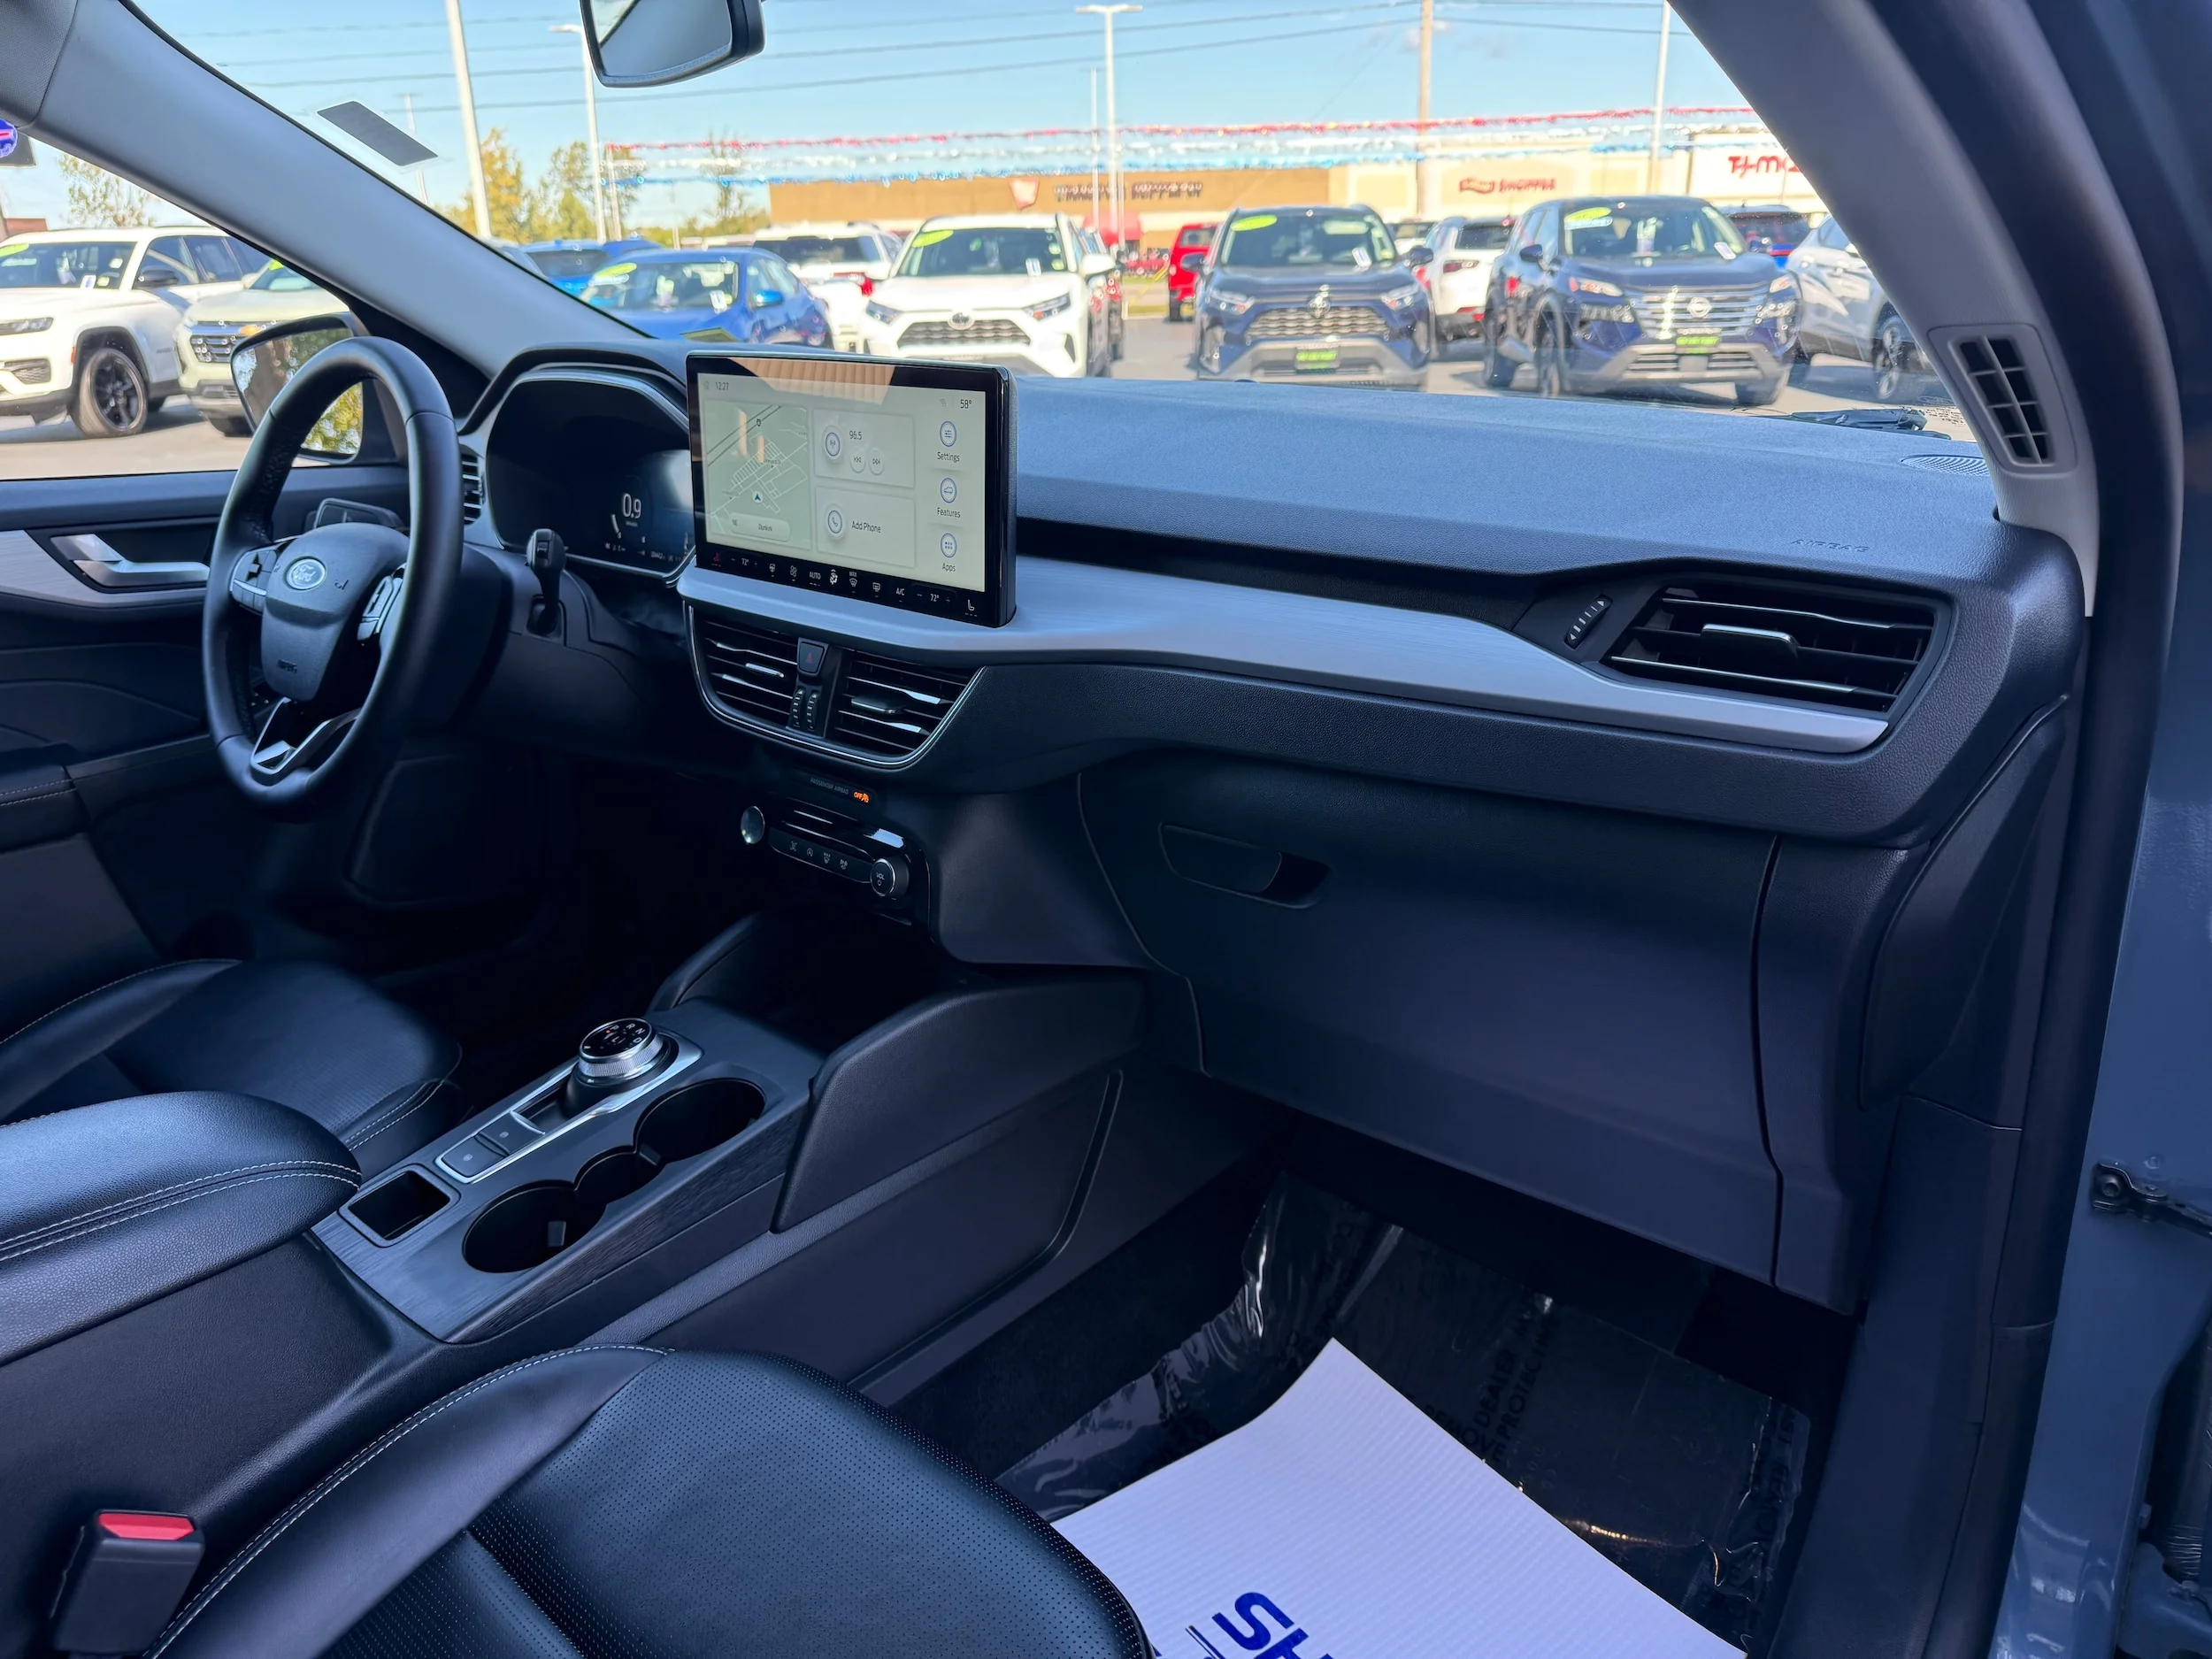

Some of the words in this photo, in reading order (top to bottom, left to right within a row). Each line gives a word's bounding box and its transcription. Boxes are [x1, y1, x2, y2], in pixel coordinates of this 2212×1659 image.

[960, 399, 972, 409] 58°
[849, 430, 862, 441] 96.5
[937, 451, 960, 463] Settings
[623, 493, 641, 518] 0.9
[937, 507, 961, 518] Features
[851, 520, 863, 530] Add
[863, 522, 881, 533] Phone
[941, 563, 956, 572] Apps
[809, 571, 821, 580] AUTO
[895, 588, 905, 596] A/C
